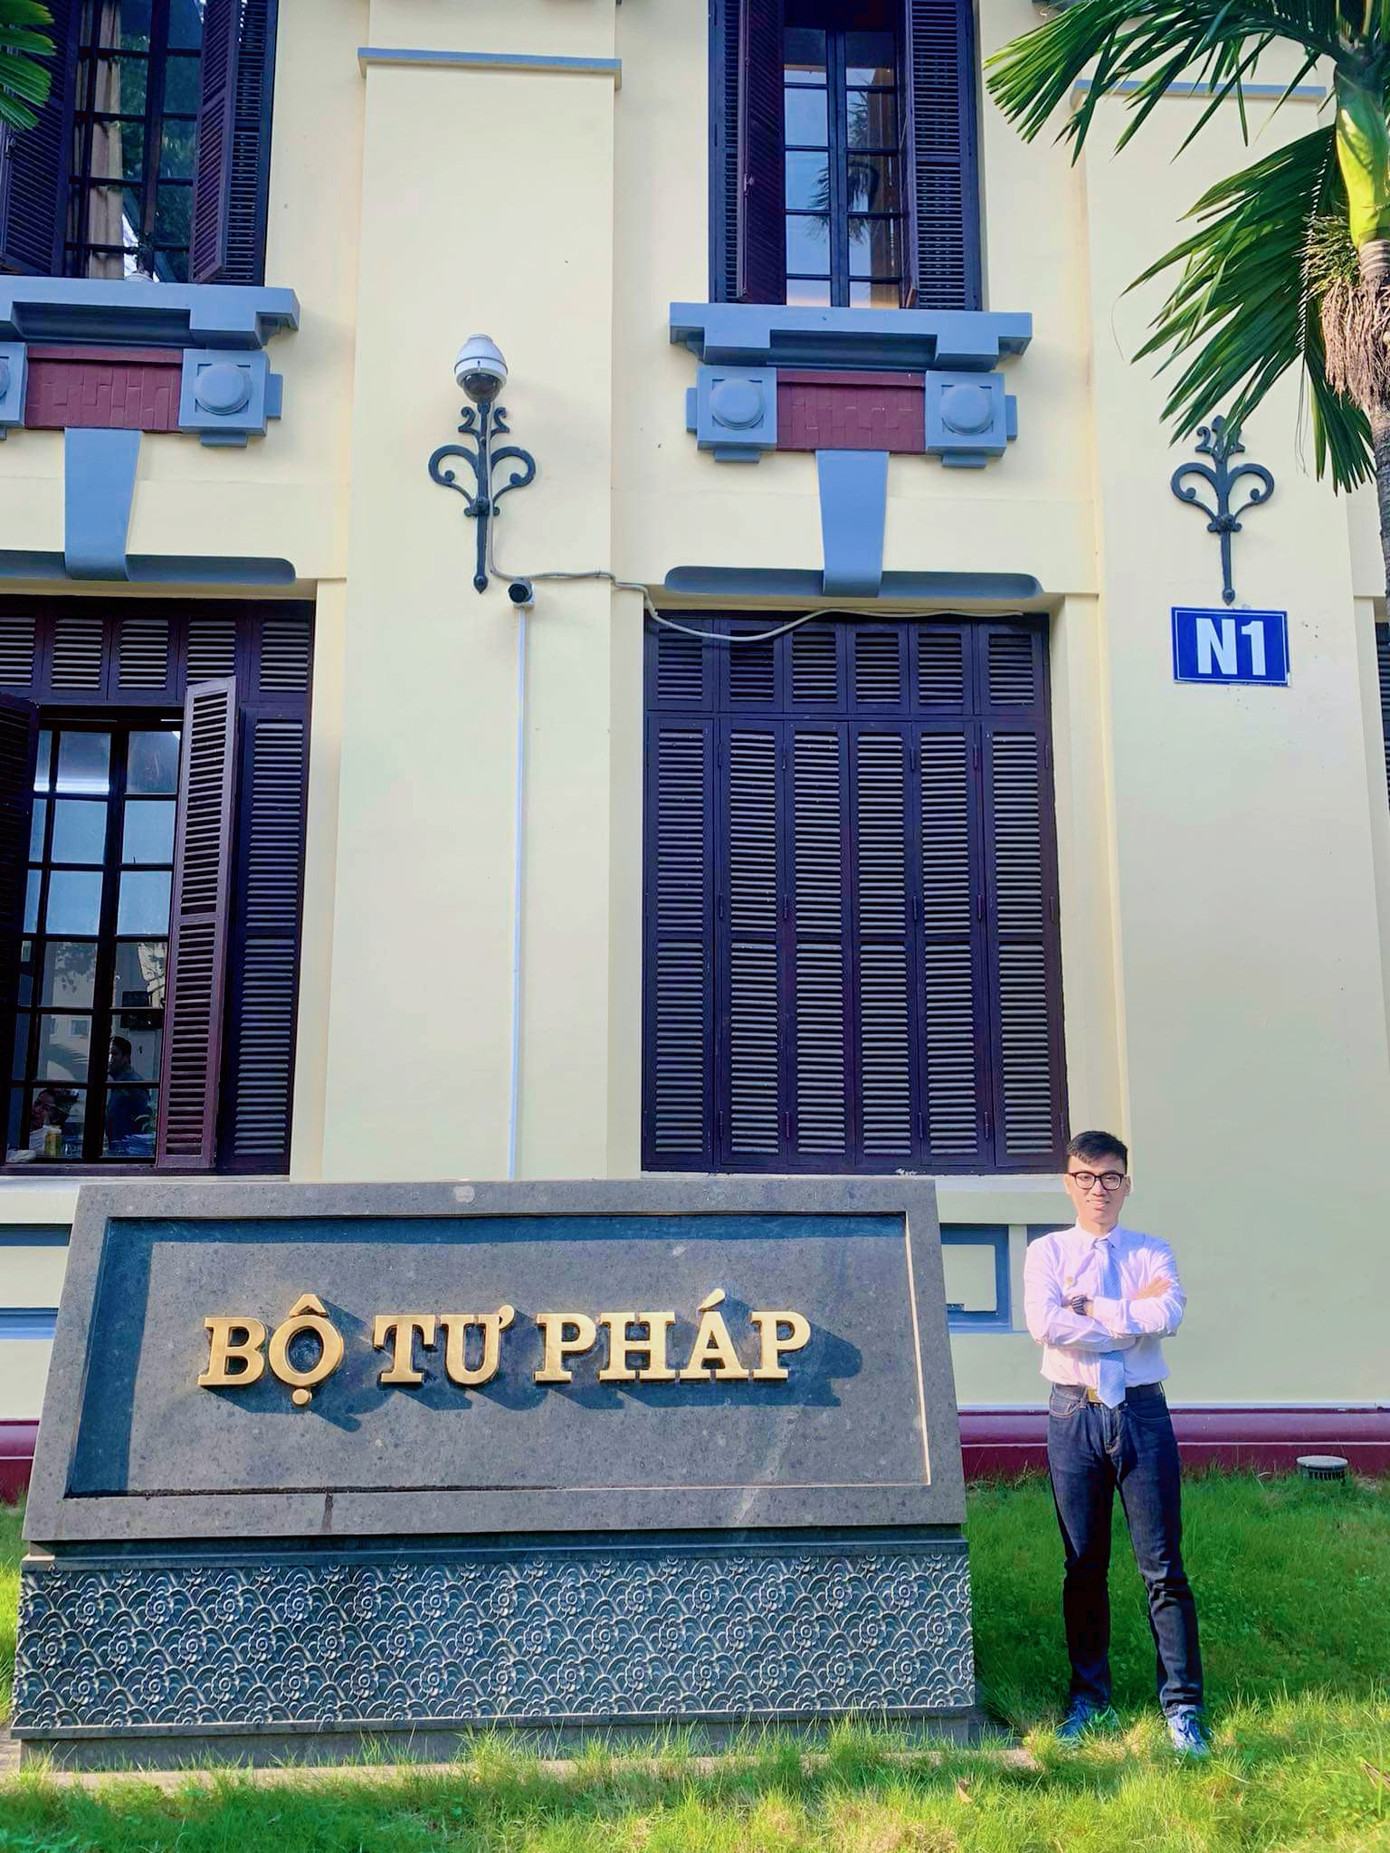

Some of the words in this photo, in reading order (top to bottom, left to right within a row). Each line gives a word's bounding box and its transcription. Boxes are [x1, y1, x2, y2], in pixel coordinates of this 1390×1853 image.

[1196, 618, 1266, 676] N1
[198, 1294, 344, 1406] BỘ
[373, 1304, 515, 1385] TƯ
[535, 1288, 811, 1382] PHÁP
